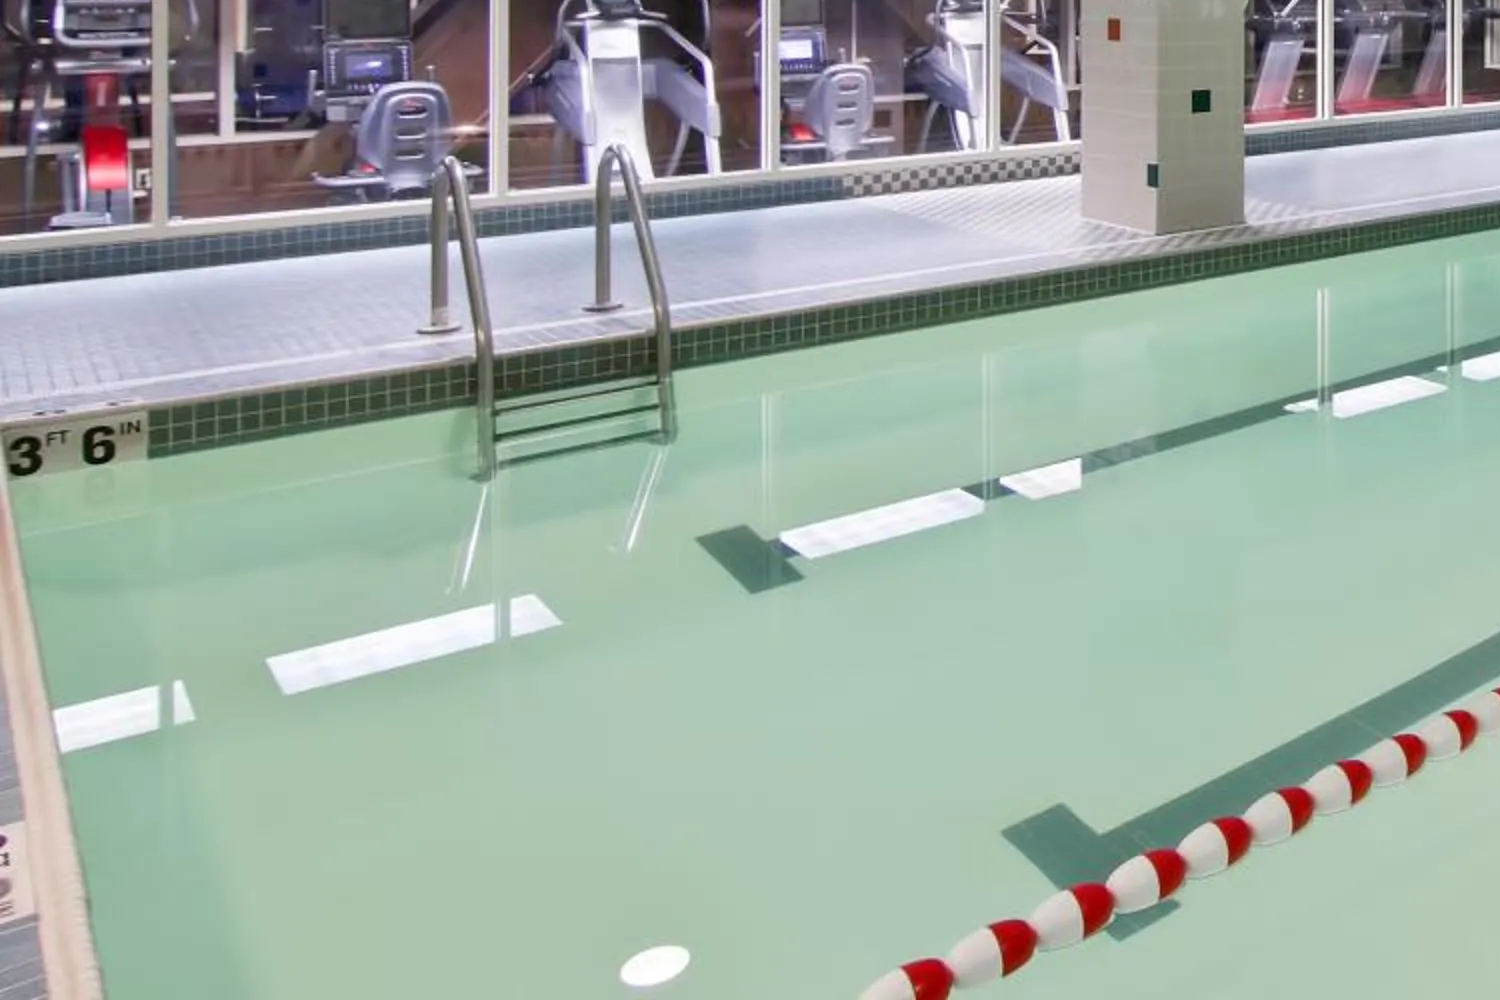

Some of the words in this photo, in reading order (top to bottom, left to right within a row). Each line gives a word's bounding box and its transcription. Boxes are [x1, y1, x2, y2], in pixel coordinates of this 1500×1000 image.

[10, 436, 43, 476] 3
[46, 430, 71, 447] FT
[83, 426, 117, 465] 6
[120, 420, 141, 435] IN
